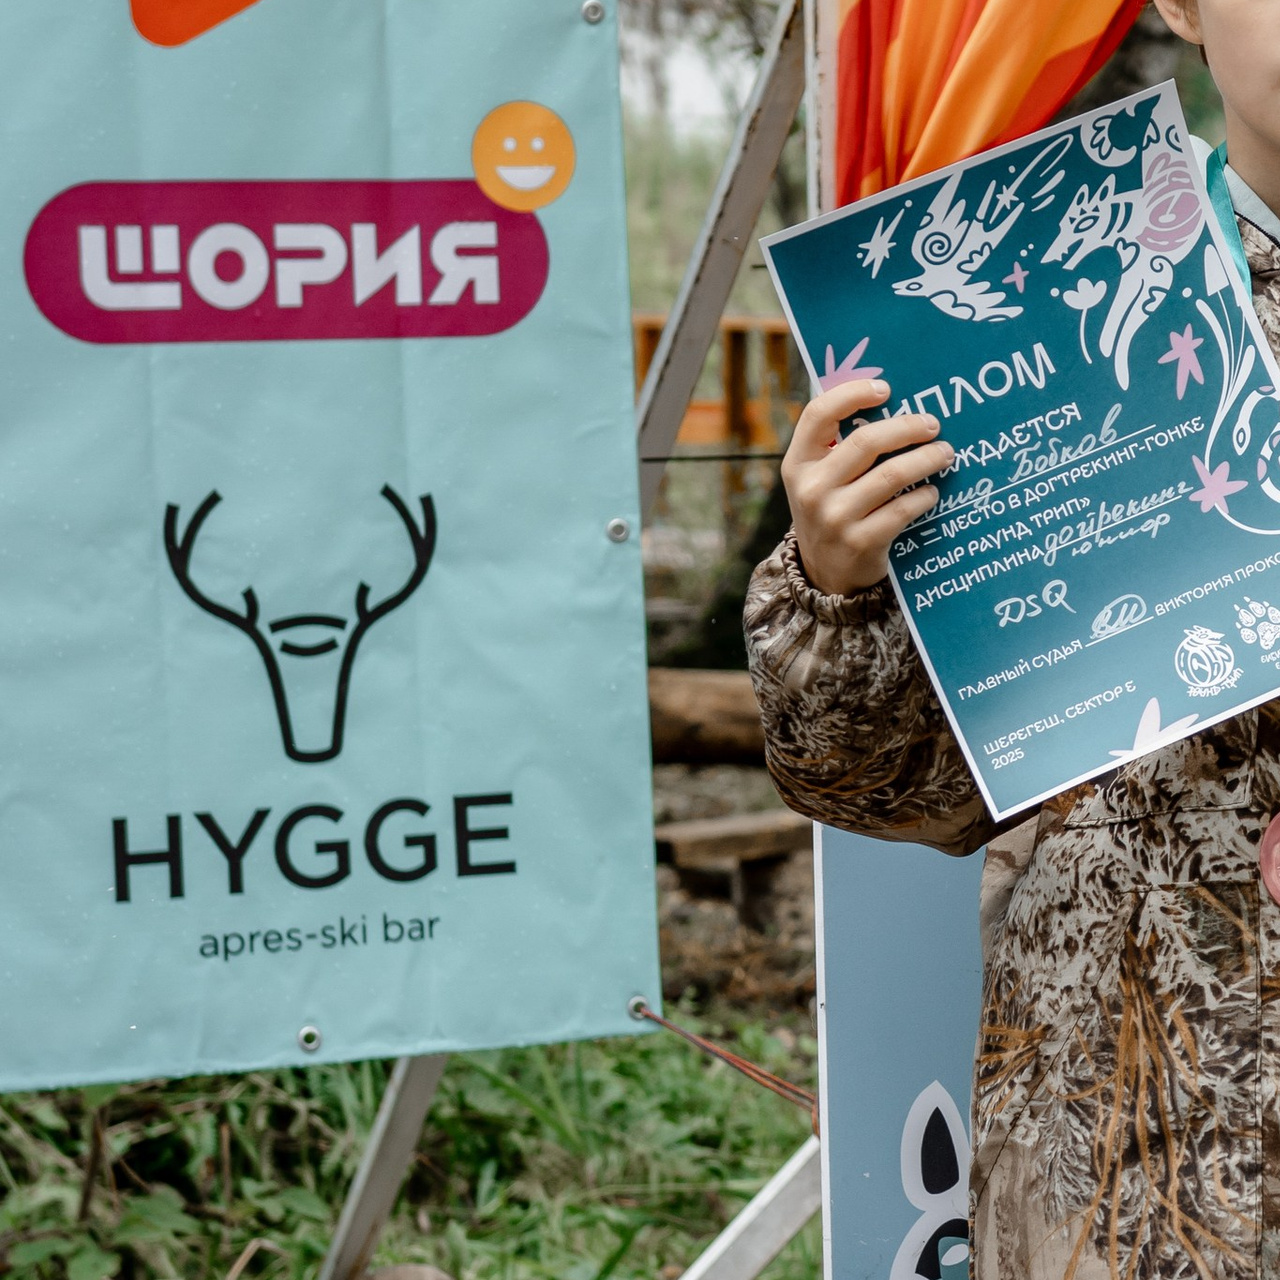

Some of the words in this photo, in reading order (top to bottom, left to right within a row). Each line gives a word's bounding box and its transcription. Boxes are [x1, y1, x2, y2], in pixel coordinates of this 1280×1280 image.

[78, 220, 501, 311] ШОРИЯ
[853, 342, 1056, 426] ИПЛОМ
[942, 501, 1006, 538] МЕСТО
[1008, 494, 1022, 510] В
[914, 545, 1044, 612] ДИСЦИПЛИНА
[994, 579, 1077, 628] DSQ
[957, 658, 1031, 701] ГЛАВНЫЙ
[1032, 639, 1083, 670] СУДЬЯ
[1155, 573, 1234, 617] ВИКТОРИЯ
[983, 713, 1065, 755] ШЕРЕГЕШ,
[1065, 685, 1123, 719] СЕКТОР
[991, 747, 1025, 770] 2025
[111, 792, 518, 903] HYGGE
[198, 914, 368, 961] apres-ski
[382, 911, 441, 944] bar
